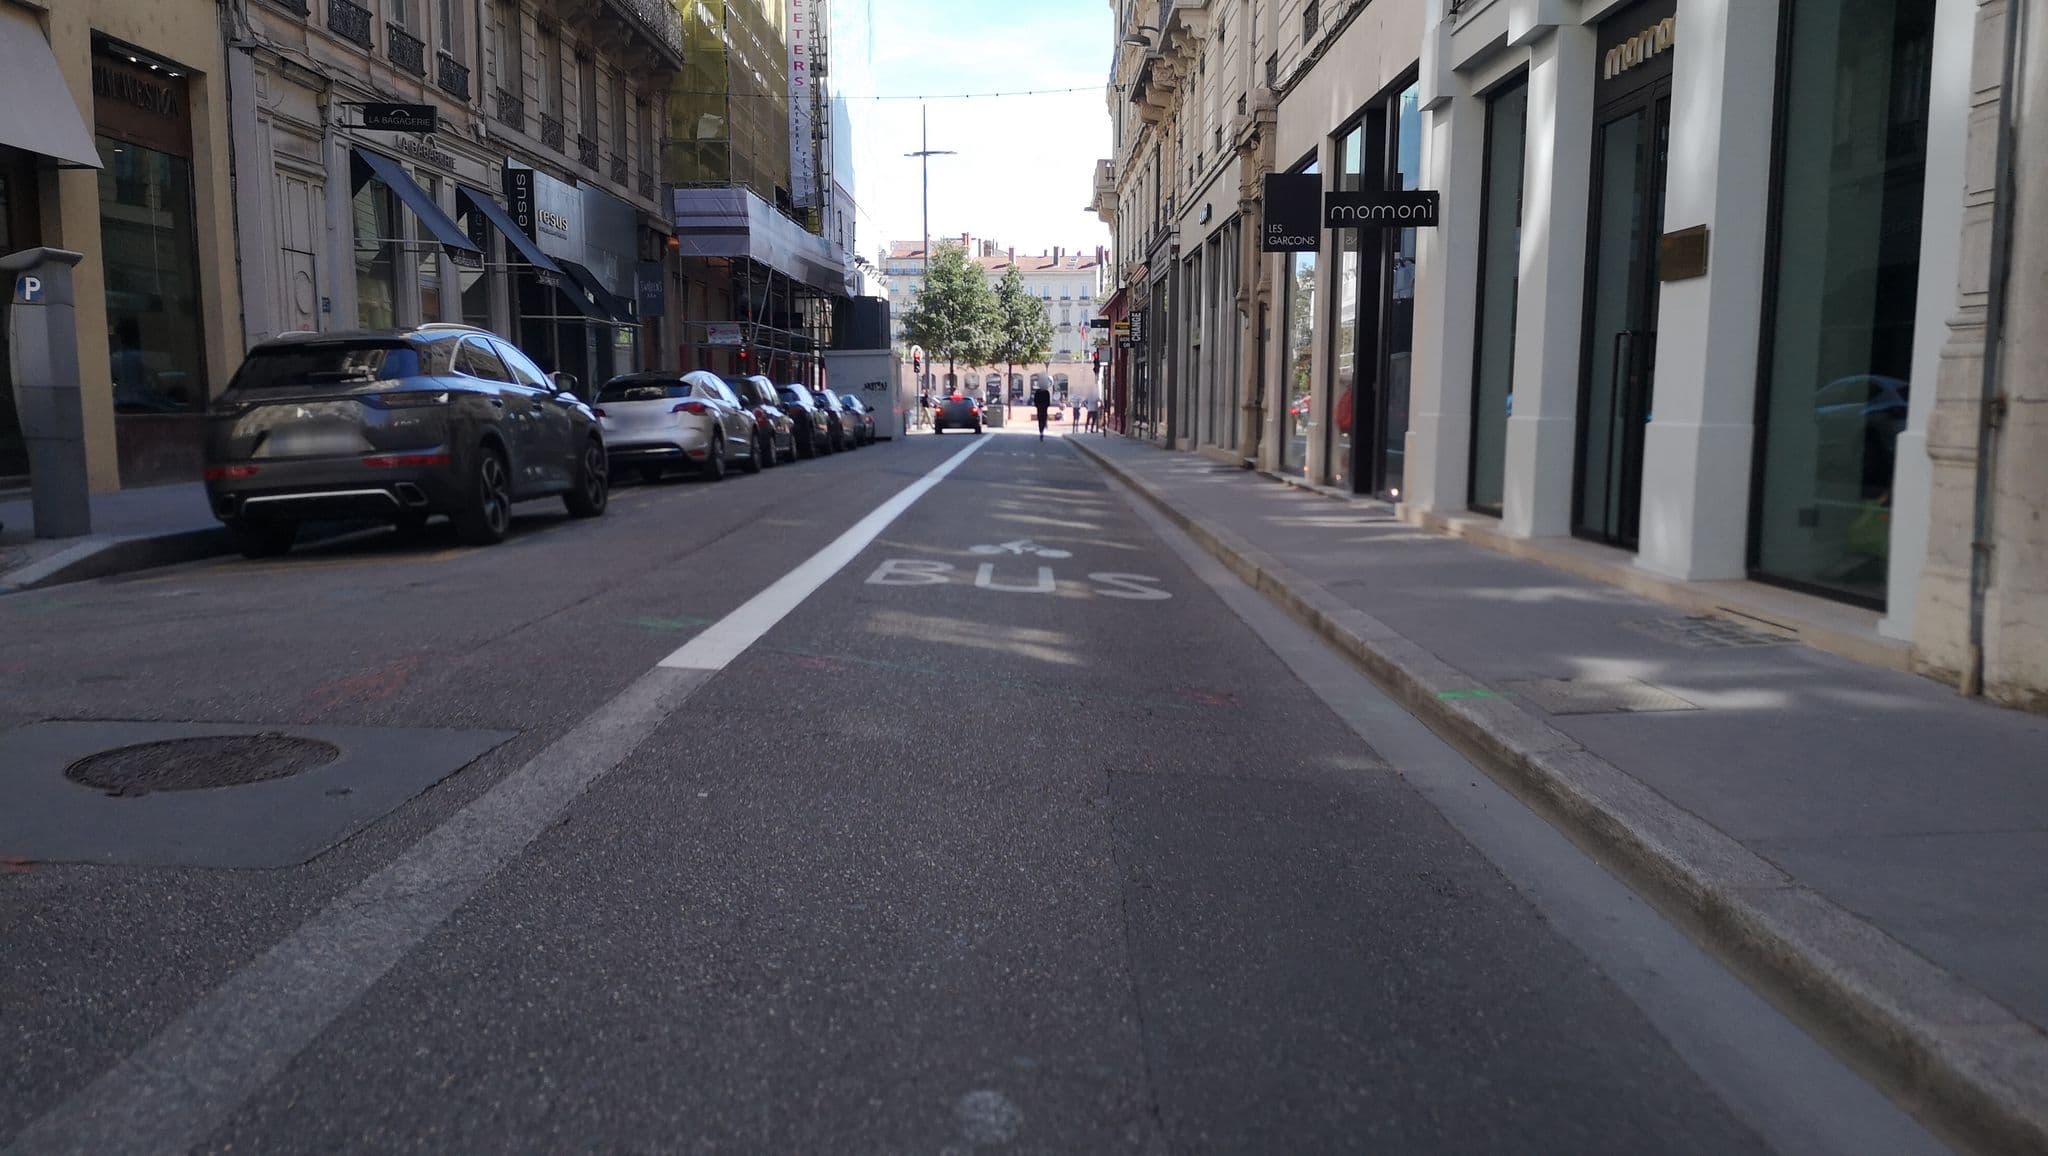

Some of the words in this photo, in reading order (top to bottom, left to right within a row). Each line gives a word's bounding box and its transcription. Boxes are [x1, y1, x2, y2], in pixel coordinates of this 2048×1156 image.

[1604, 17, 1676, 80] momo
[368, 116, 379, 124] LA
[382, 116, 430, 127] BAGAGERIE
[538, 209, 569, 232] resus
[1268, 224, 1283, 234] LES
[25, 276, 41, 301] P
[1131, 312, 1142, 342] CHANGE
[864, 558, 1174, 601] BUS
